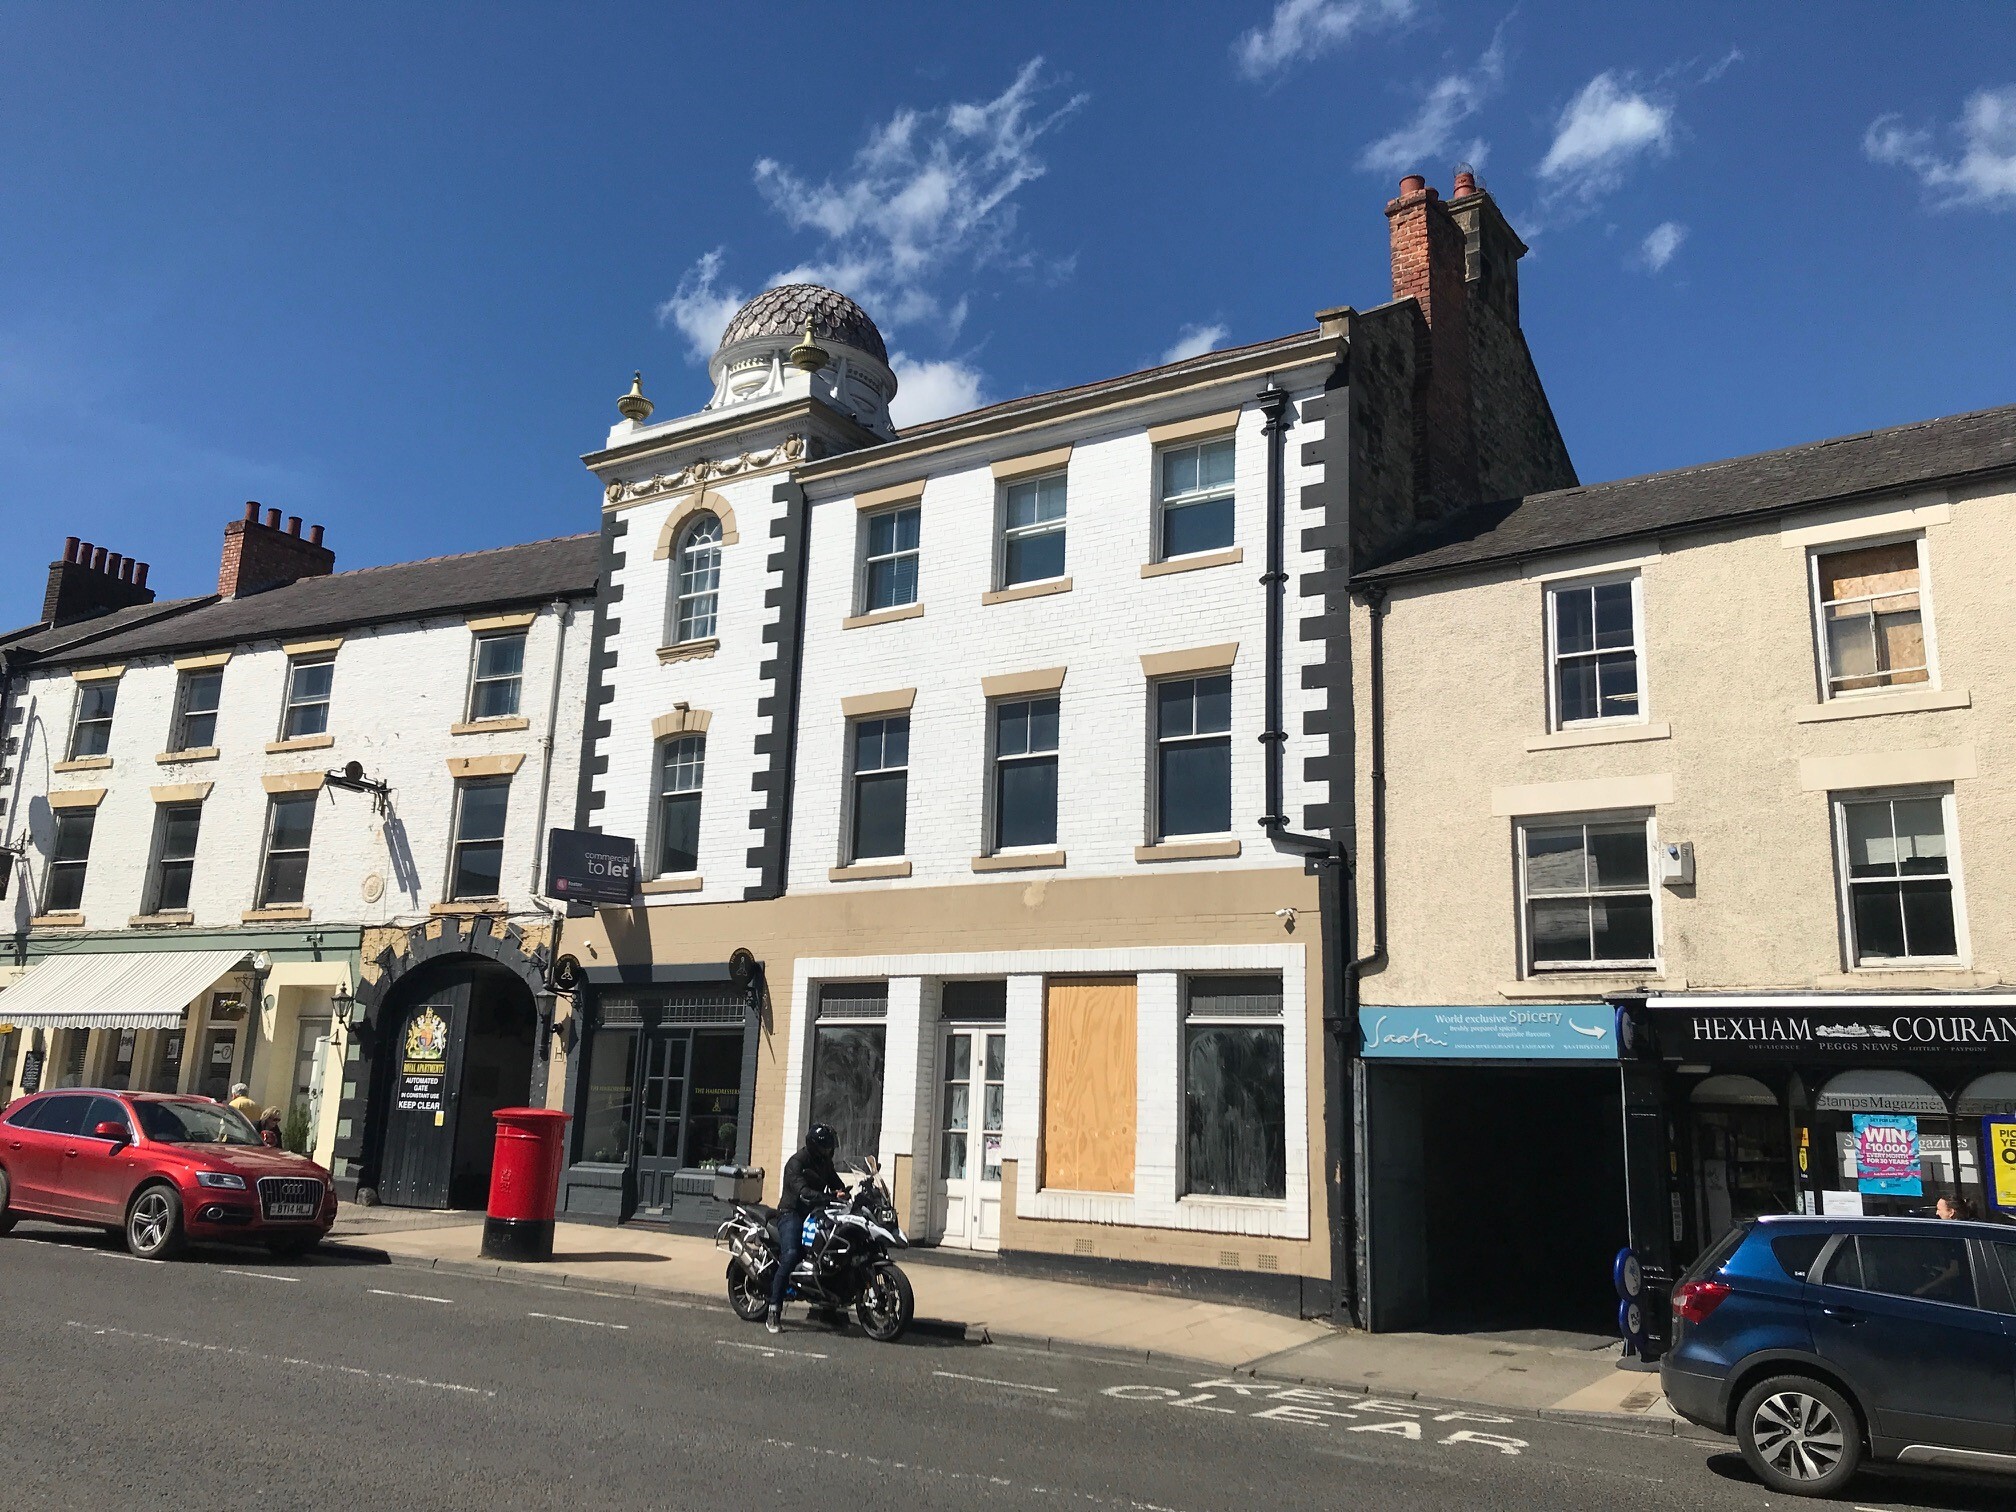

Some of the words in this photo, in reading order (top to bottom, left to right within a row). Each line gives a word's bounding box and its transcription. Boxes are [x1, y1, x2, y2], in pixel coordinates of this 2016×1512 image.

[585, 852, 631, 864] commercial
[588, 860, 605, 875] to
[607, 861, 629, 878] let
[1434, 1014, 1463, 1024] World
[1464, 1014, 1508, 1024] exclusive
[1508, 1010, 1562, 1025] Spicery
[1692, 1017, 1813, 1041] HEXHAM
[1819, 1042, 1859, 1050] PEGGS
[1862, 1042, 1898, 1051] NEWS
[417, 1062, 444, 1073] APARTMENTS
[414, 1084, 428, 1092] GATE
[398, 1100, 416, 1109] KEEP
[417, 1101, 440, 1110] CLEAR
[1817, 1095, 1868, 1108] Stamps
[1869, 1096, 1944, 1111] Magazines
[1864, 1128, 1907, 1144] WIN
[1866, 1143, 1908, 1154] £10,000
[1189, 1378, 1514, 1424] KEEP
[1099, 1384, 1531, 1456] CLEAR
